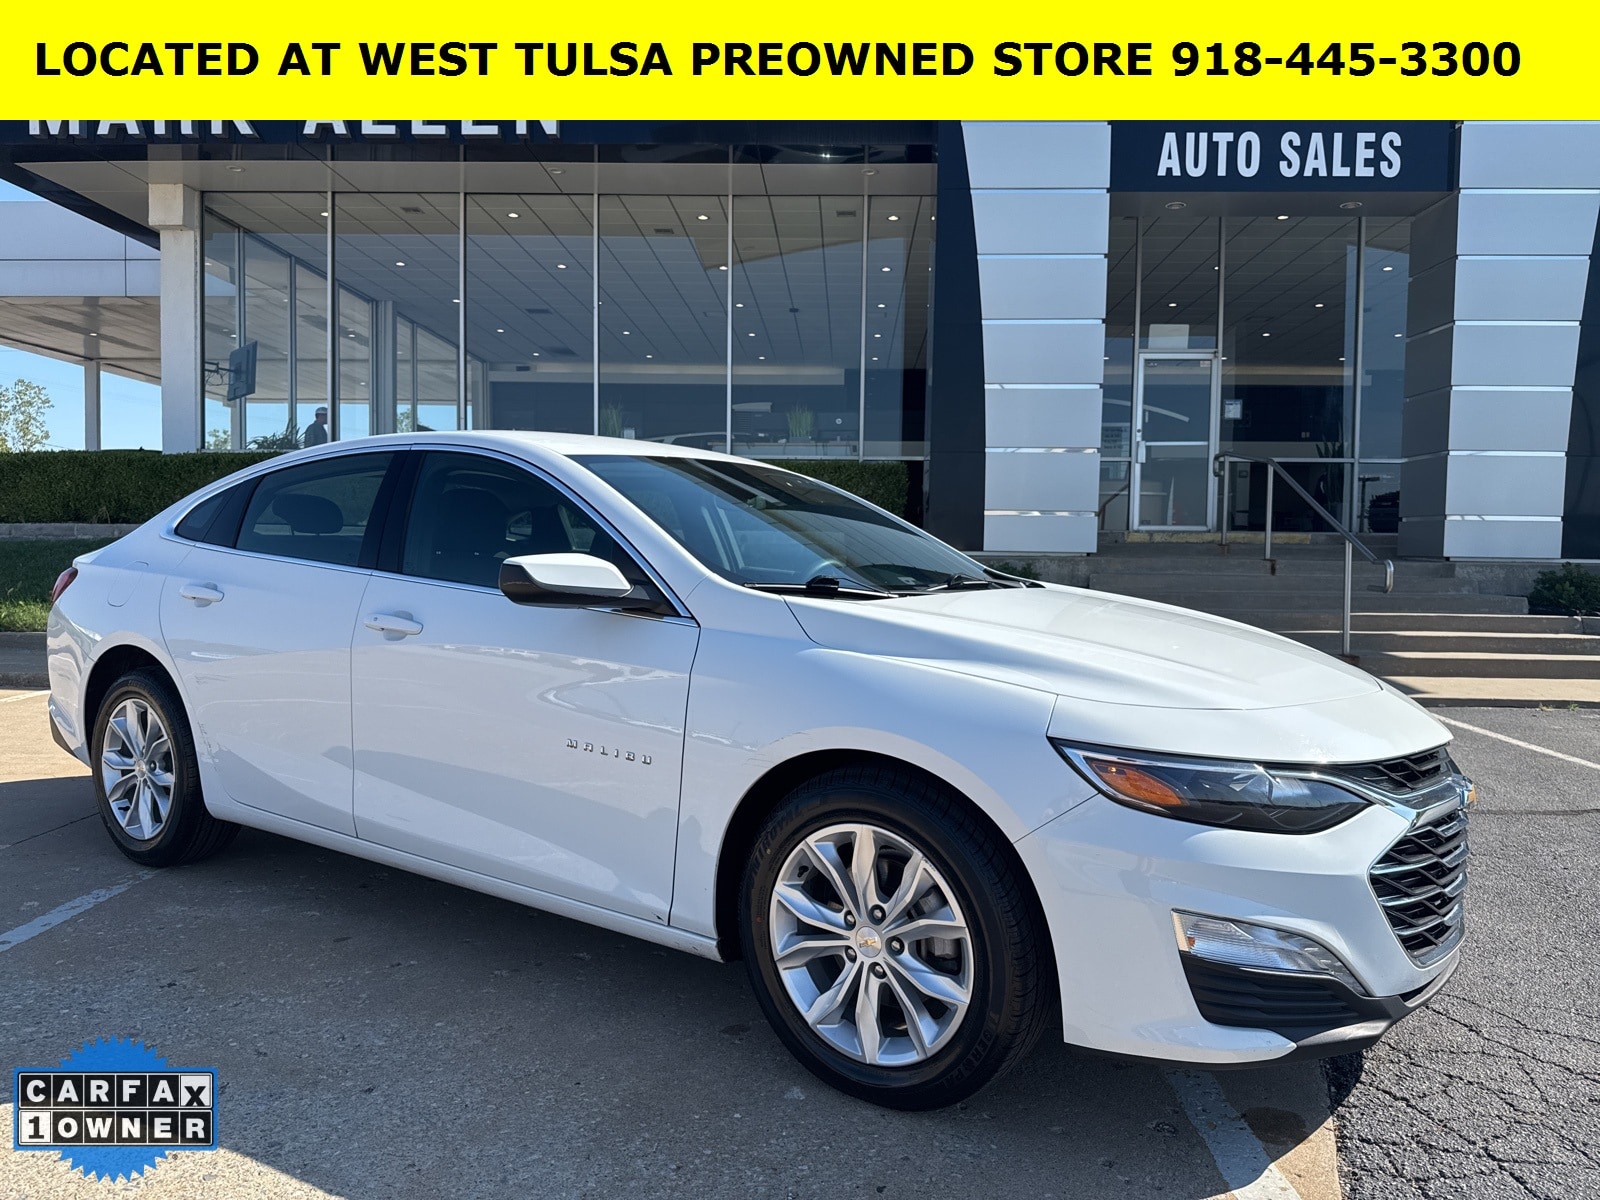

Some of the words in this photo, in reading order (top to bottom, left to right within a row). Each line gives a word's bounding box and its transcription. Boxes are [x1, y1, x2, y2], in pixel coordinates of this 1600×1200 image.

[1157, 131, 1261, 178] AUTO
[1279, 131, 1402, 178] SALES
[566, 738, 652, 765] MALIBU
